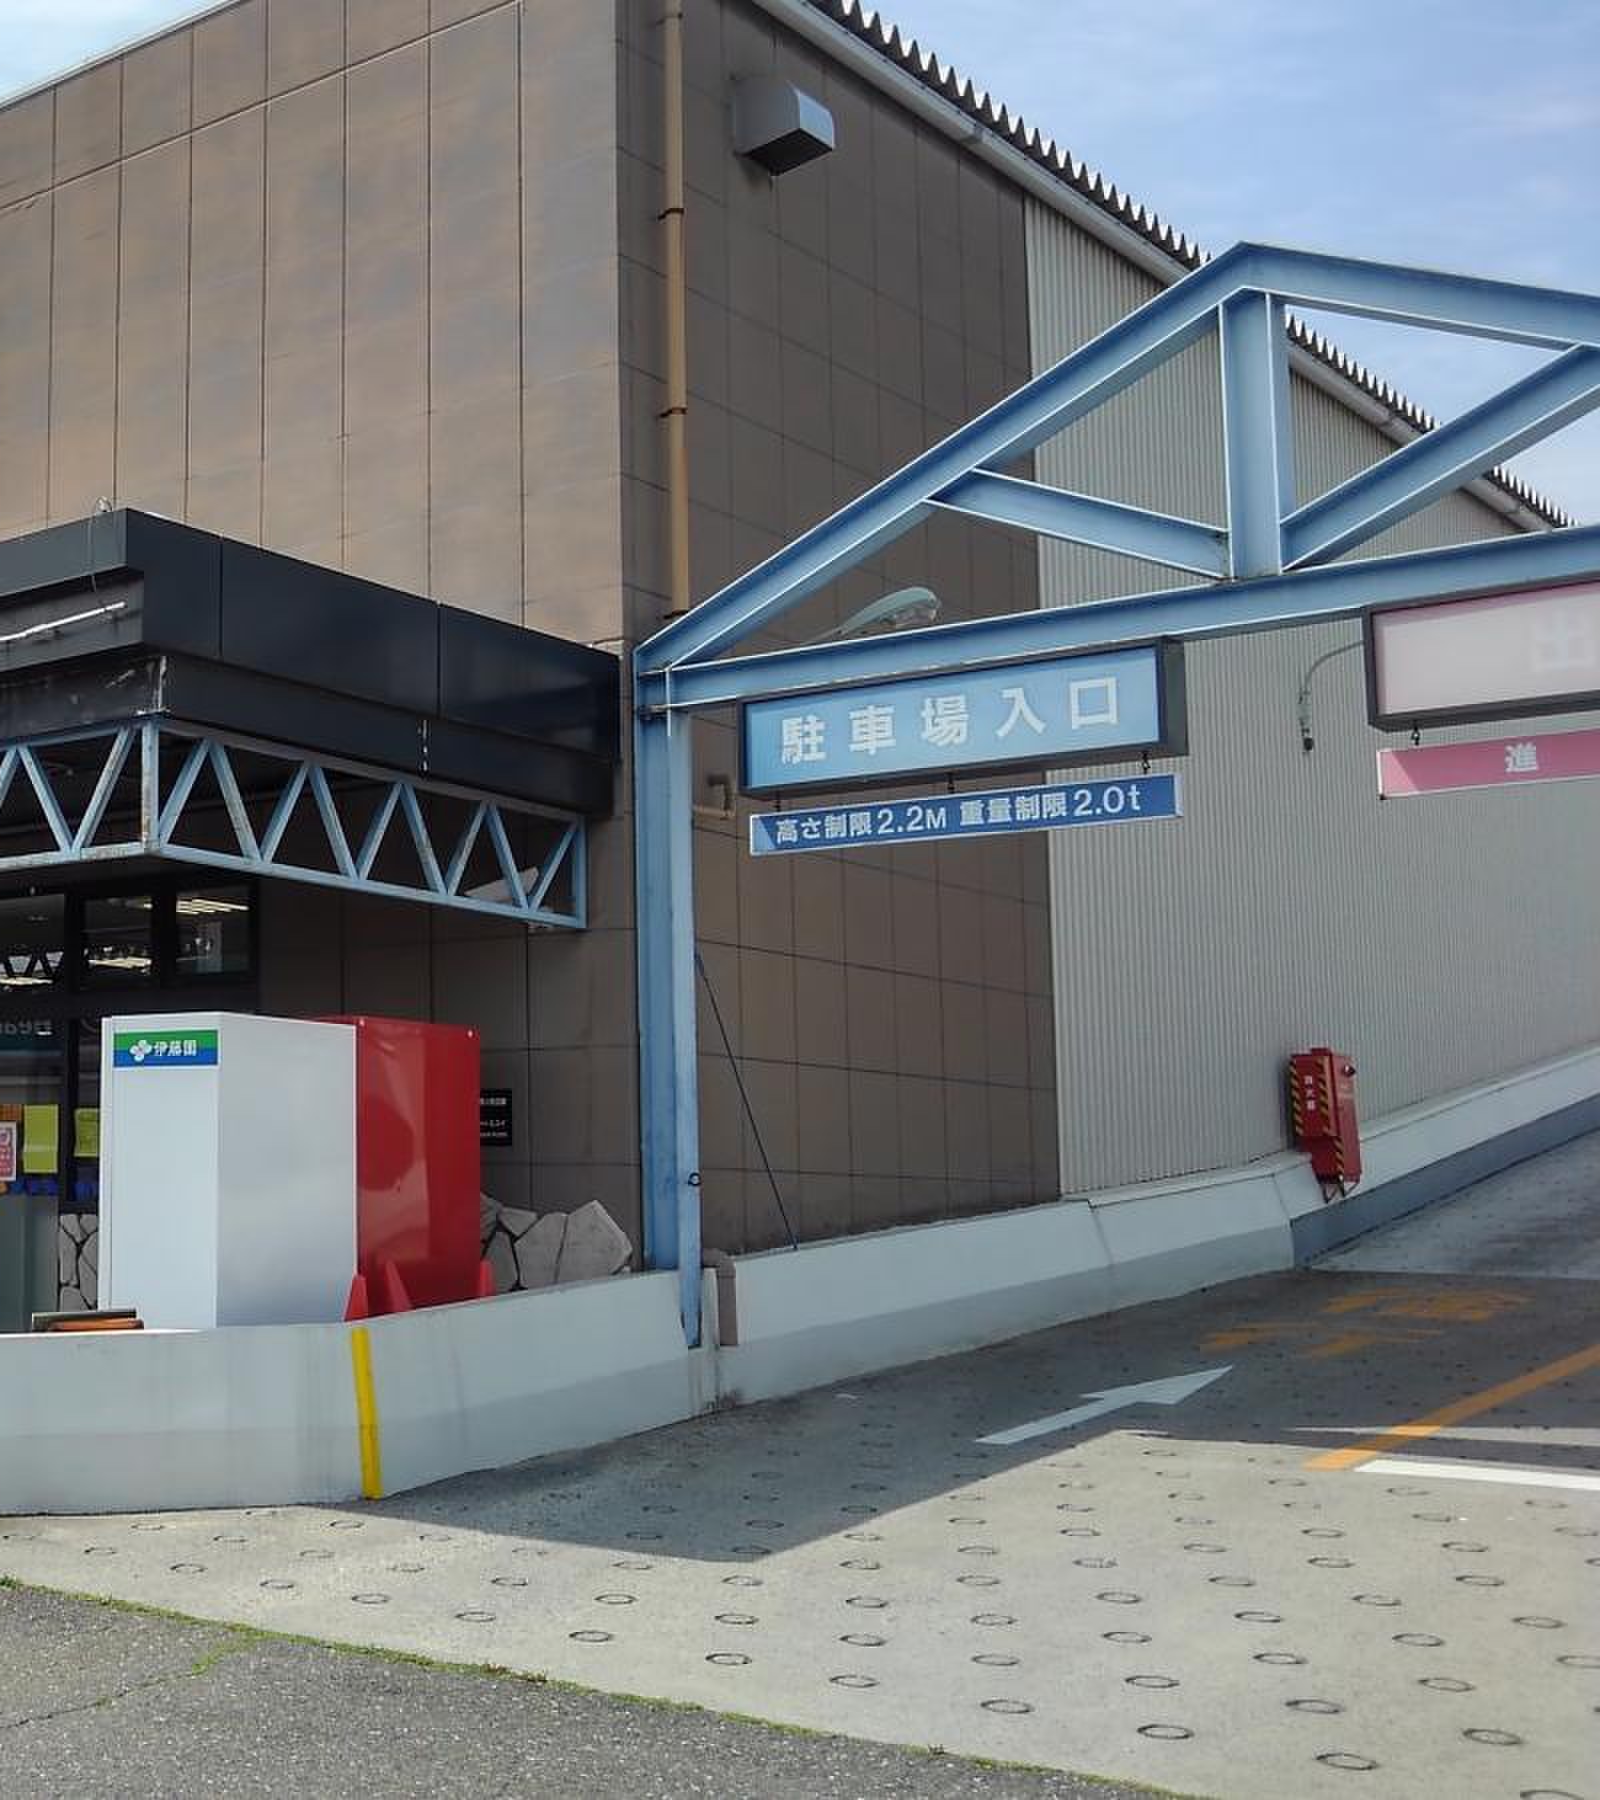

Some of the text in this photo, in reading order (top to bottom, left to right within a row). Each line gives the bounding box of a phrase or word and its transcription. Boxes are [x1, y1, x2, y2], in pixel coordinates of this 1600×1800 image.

[780, 676, 1120, 765] 駐車場入口
[958, 783, 1142, 826] 重量制限2.0t
